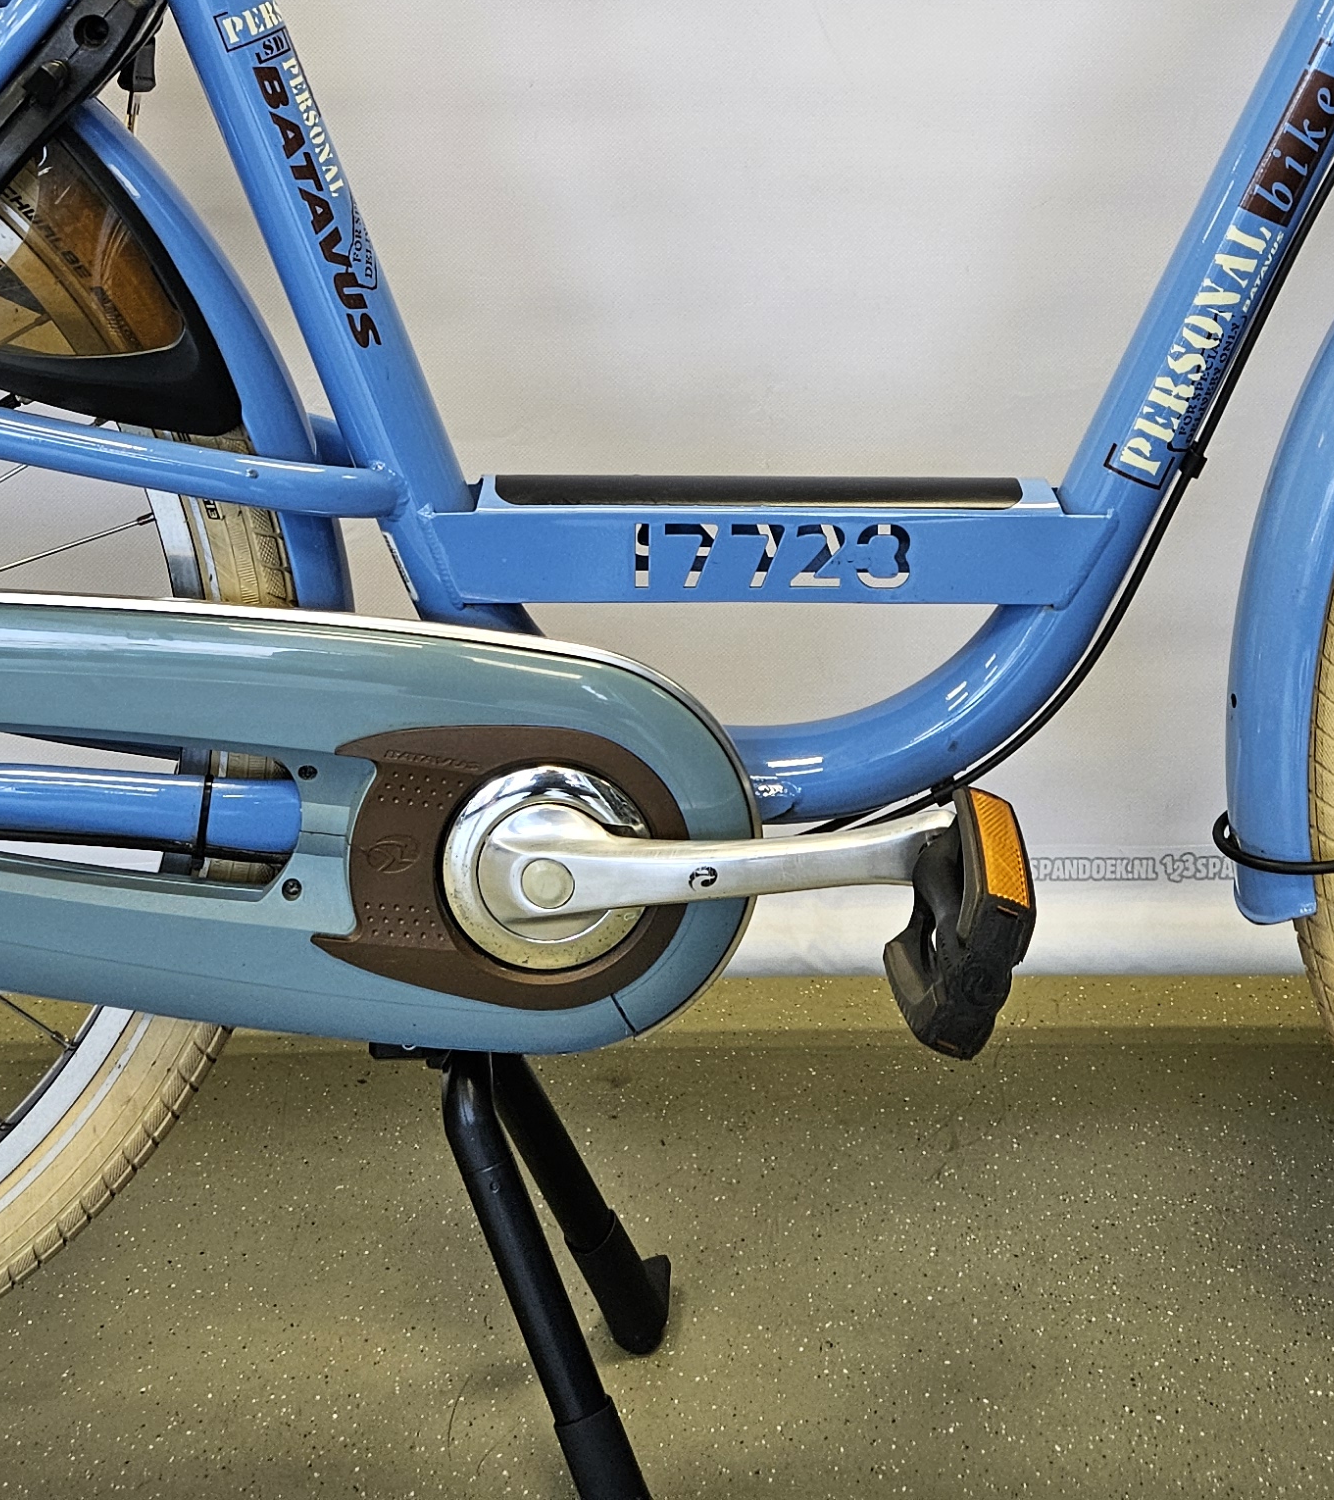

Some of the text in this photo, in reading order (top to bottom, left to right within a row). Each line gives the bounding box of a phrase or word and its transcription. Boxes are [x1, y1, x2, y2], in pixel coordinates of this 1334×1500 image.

[263, 35, 285, 56] SD
[281, 56, 345, 198] PERSONAL
[252, 66, 382, 349] BATAVUS
[1242, 231, 1286, 315] BATAVUS
[1120, 226, 1274, 478] PERSONAL
[1218, 320, 1242, 362] ONLY
[1177, 401, 1199, 437] FOR
[634, 522, 911, 589] 17723
[384, 749, 480, 771] BATAVUS
